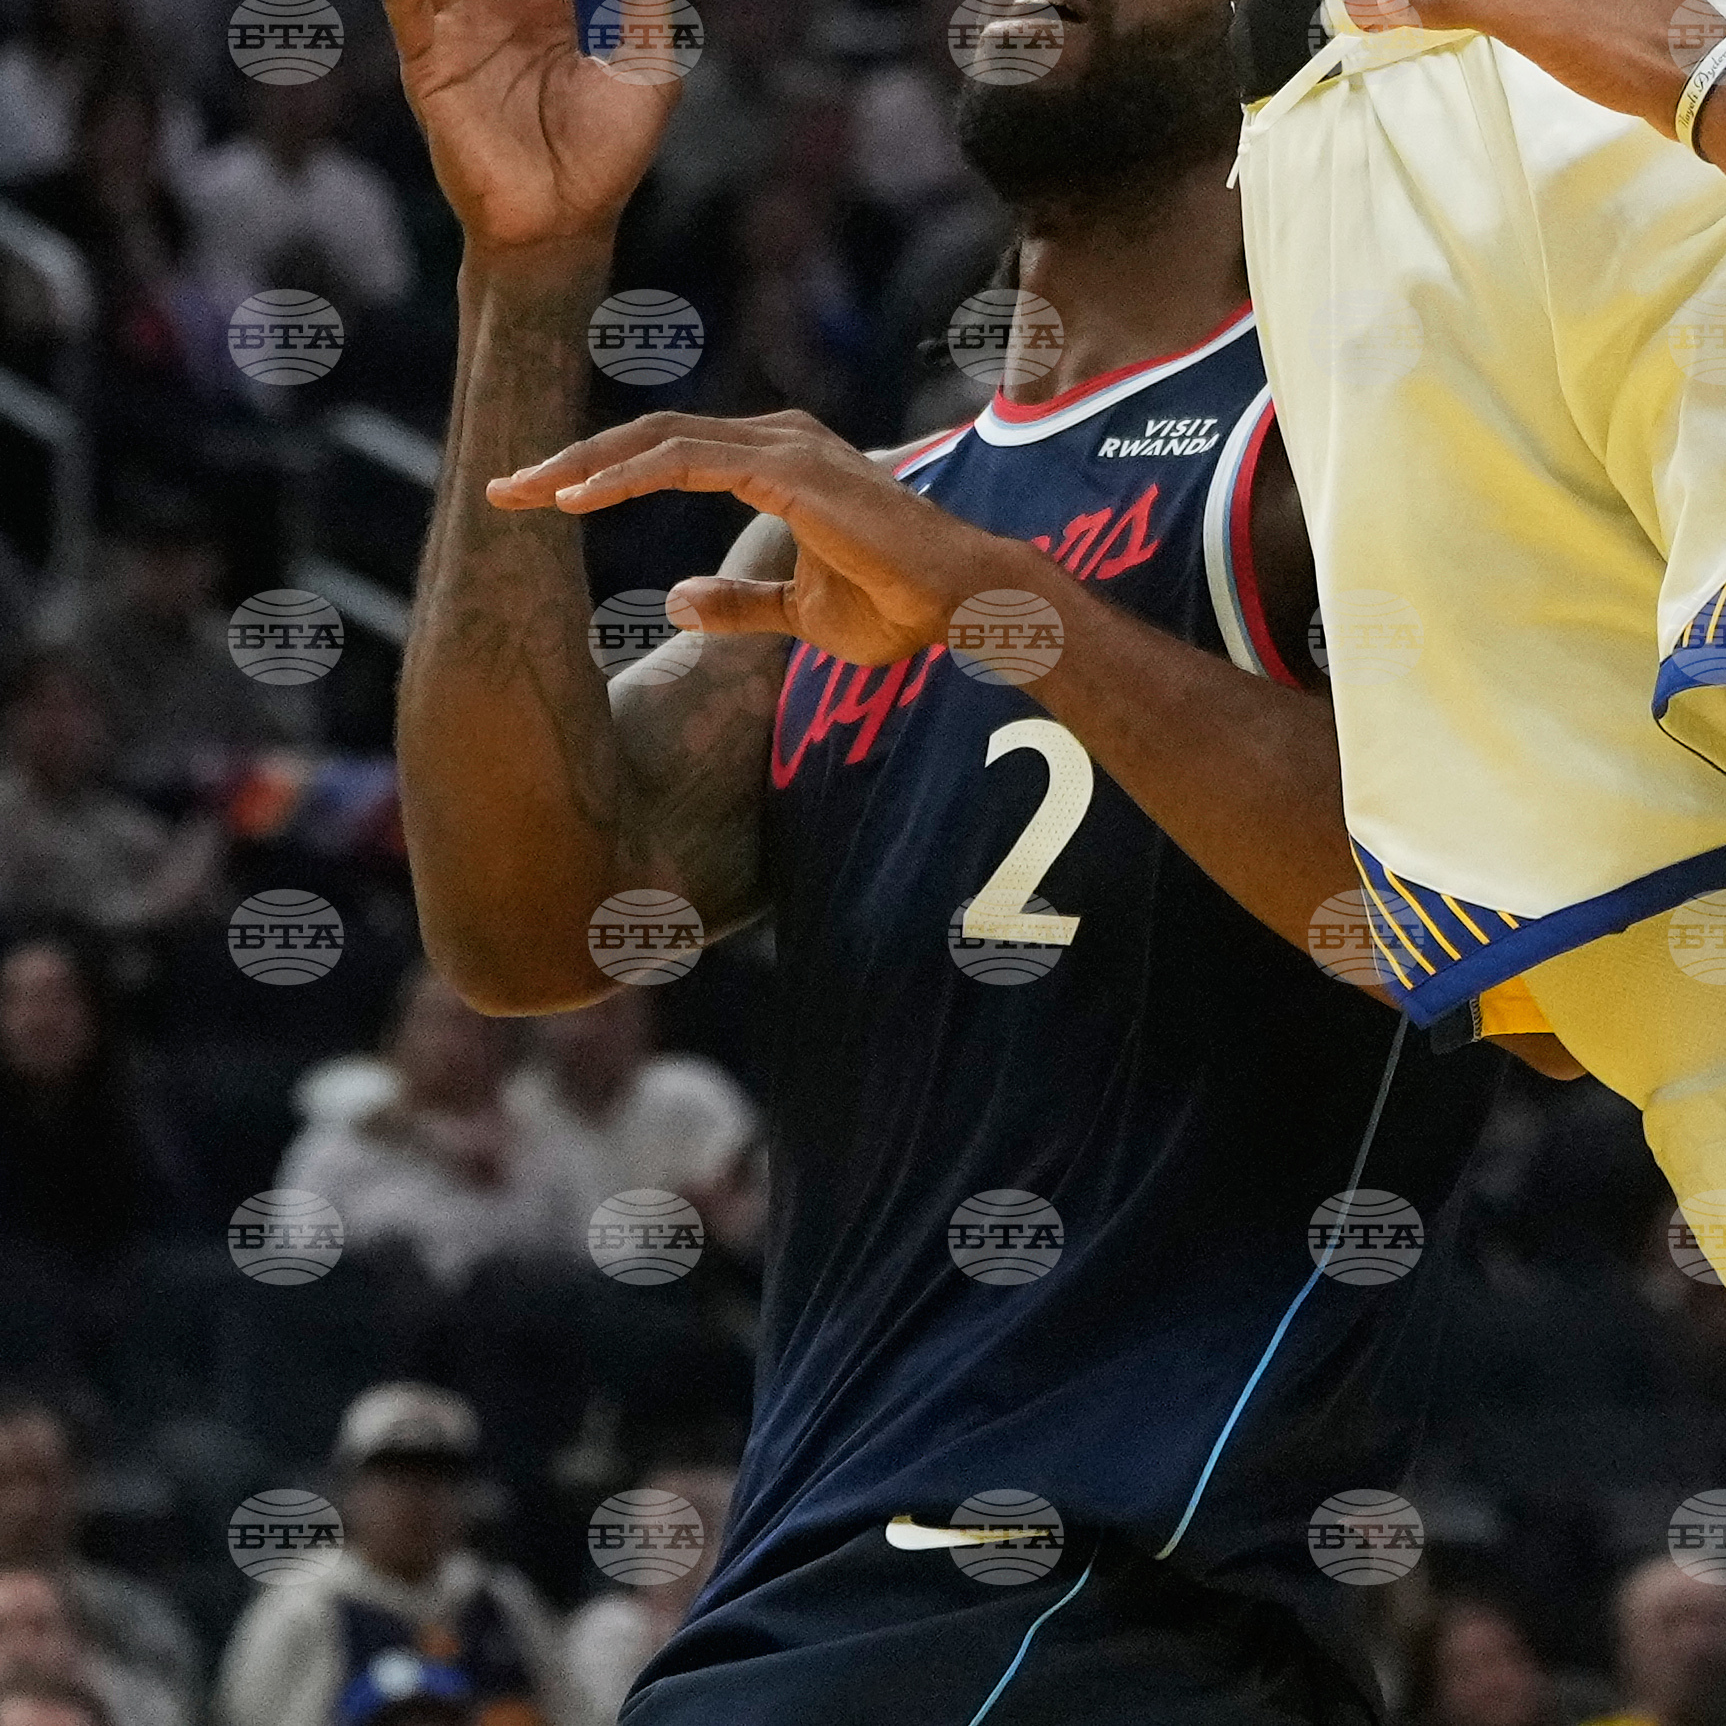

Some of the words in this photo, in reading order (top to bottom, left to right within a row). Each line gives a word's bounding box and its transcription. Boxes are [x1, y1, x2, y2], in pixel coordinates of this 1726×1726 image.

[1145, 418, 1218, 437] VISIT
[1097, 432, 1220, 458] RWANDA
[962, 718, 1094, 946] 2
